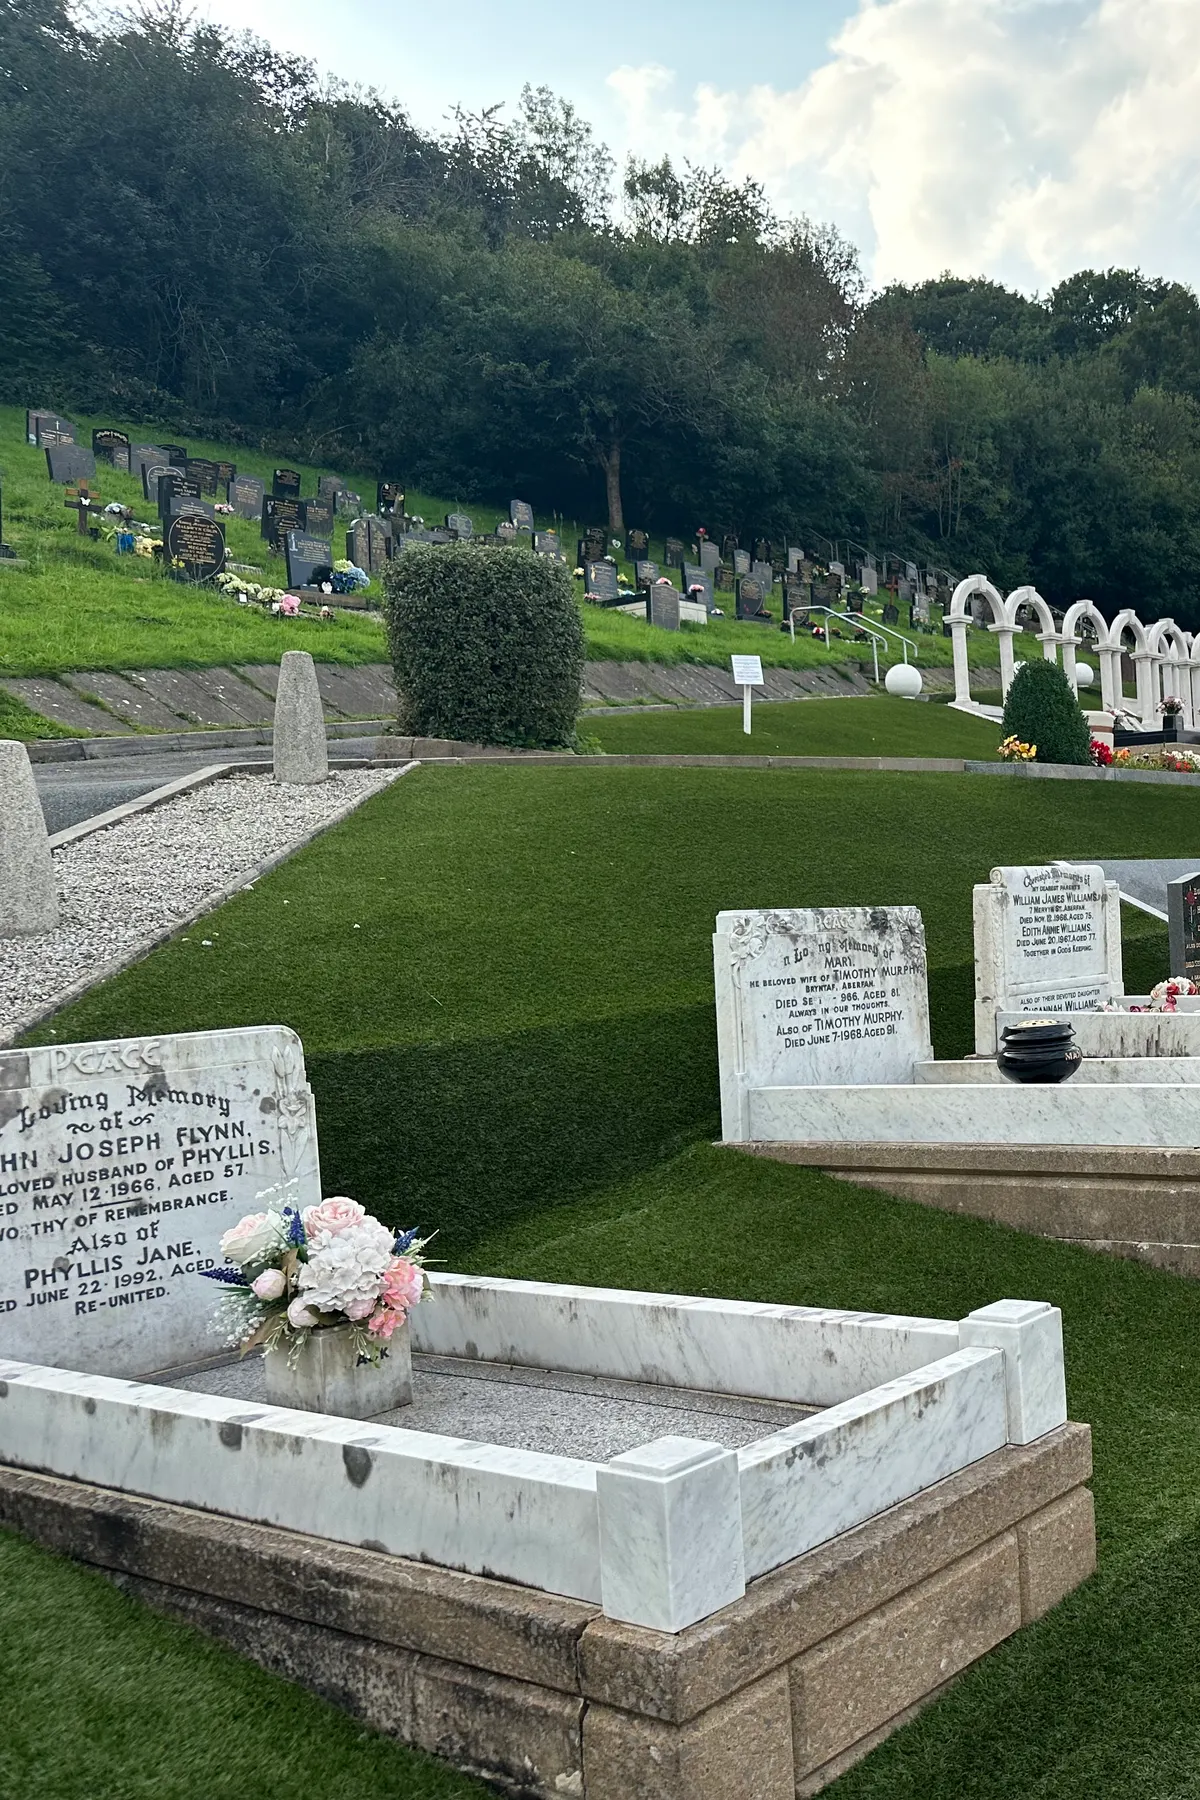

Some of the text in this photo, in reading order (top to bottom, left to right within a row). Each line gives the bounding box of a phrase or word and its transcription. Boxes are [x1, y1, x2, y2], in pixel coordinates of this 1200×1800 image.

[1013, 894, 1041, 906] WILLIAM
[1042, 893, 1065, 904] JAMES
[1020, 916, 1034, 924] DIED
[1022, 926, 1041, 937] EDITH
[1042, 924, 1060, 935] ANNIE
[1017, 939, 1031, 947] DIED
[1032, 937, 1046, 946] JUNE
[1023, 949, 1050, 957] TOGETHER
[763, 978, 796, 987] BELOVED
[800, 975, 817, 984] WIFE
[820, 974, 830, 982] OF
[833, 968, 877, 981] TIMOTHY
[776, 999, 798, 1009] DIED
[863, 991, 886, 1000] AGED
[1042, 994, 1056, 1002] THEIR
[1056, 992, 1077, 1000] DEVOTED
[1078, 989, 1100, 998] DAUGHTER
[789, 1009, 817, 1019] ALWAYS
[776, 1025, 799, 1036] ALSO
[802, 1024, 812, 1032] OF
[814, 1014, 861, 1031] TIMOTHY
[785, 1037, 806, 1049] DIED
[807, 1034, 830, 1045] JUNE
[51, 1041, 161, 1076] PEACE
[16, 1084, 230, 1133] Loving Memory
[99, 1111, 122, 1131] of
[58, 1132, 161, 1164] JOSEPH
[62, 1162, 147, 1186] HUSBAND
[155, 1158, 175, 1172] OF
[33, 1192, 74, 1211] MAY
[168, 1169, 214, 1188] AGED
[223, 1163, 248, 1178] 57.
[75, 1212, 98, 1228] OF
[105, 1189, 234, 1223] REMEMBRANCE.
[65, 1232, 128, 1256] Also
[24, 1240, 202, 1289] PHYLLIS JANE,
[26, 1288, 69, 1307] JUNE
[170, 1257, 214, 1277] AGED
[75, 1286, 170, 1315] RE-UNITED.
